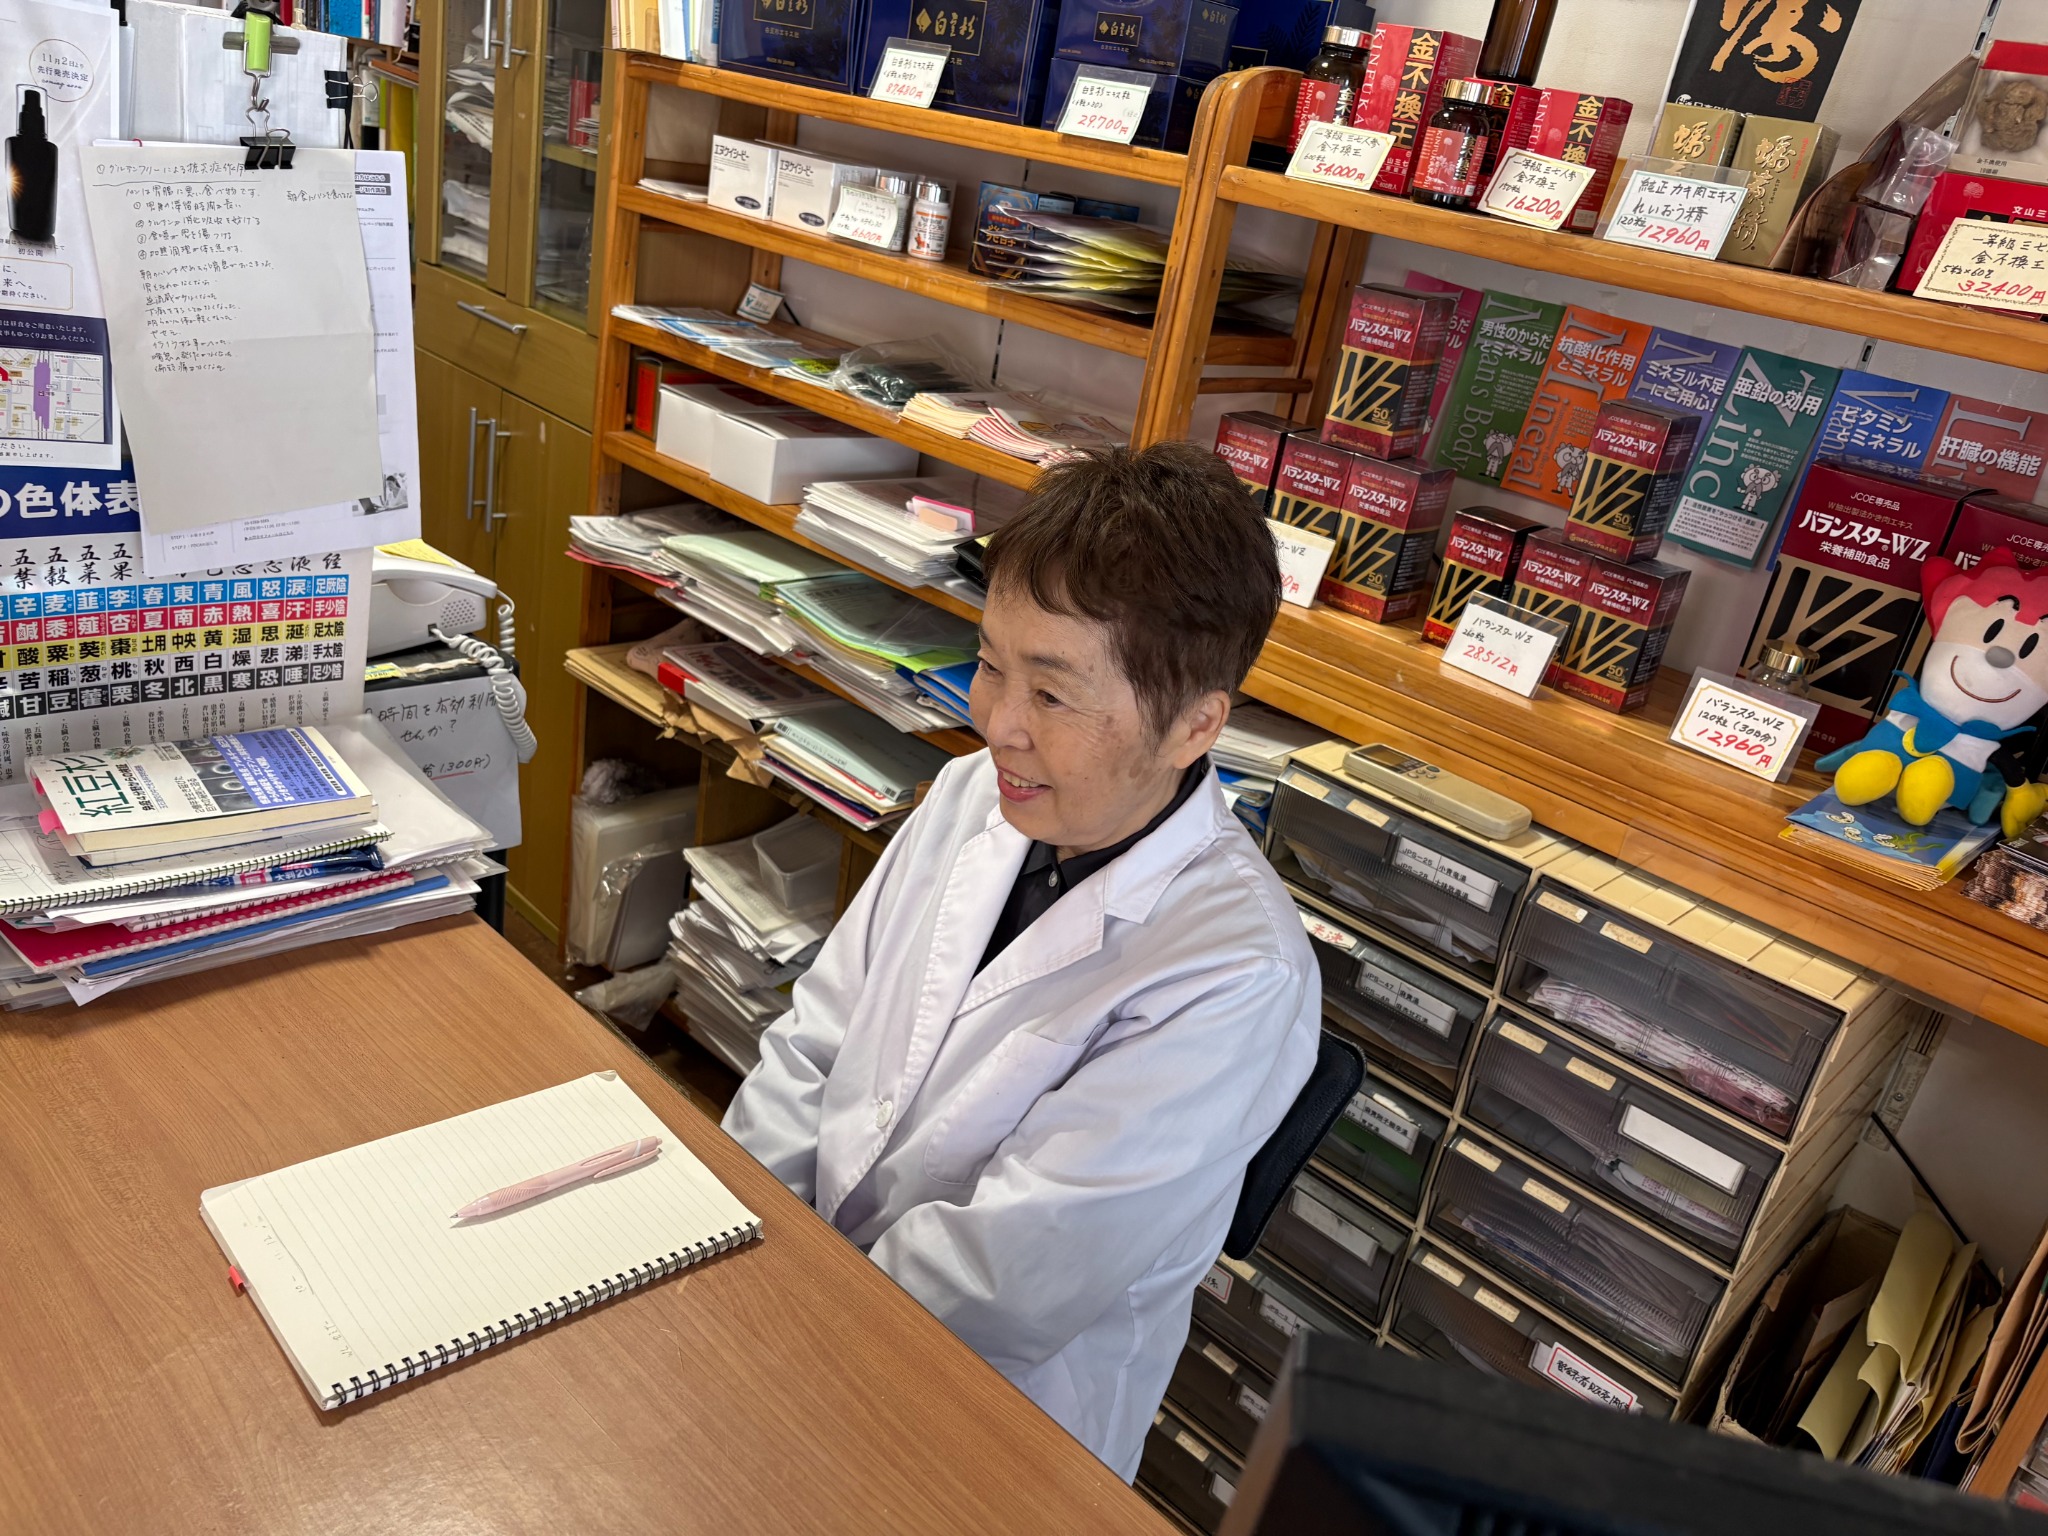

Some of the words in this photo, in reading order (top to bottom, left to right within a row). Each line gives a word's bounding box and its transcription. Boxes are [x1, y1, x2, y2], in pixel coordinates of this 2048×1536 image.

[42, 52, 85, 69] 11月2日より
[37, 65, 89, 82] 先行発売決定
[1386, 31, 1440, 149] 金不換王
[1317, 141, 1363, 158] 金不換王
[1312, 162, 1366, 182] 54,000円
[1513, 157, 1542, 175] 一等級
[1544, 165, 1578, 182] 三七人参
[1513, 170, 1558, 191] 金不換王
[1639, 177, 1668, 194] 純正
[1671, 182, 1737, 205] カキ肉エキス
[1631, 199, 1709, 224] れいおう精
[2012, 205, 2047, 219] 文山三
[1616, 215, 1647, 229] 120粒
[1638, 224, 1711, 252] 12,960円
[1972, 233, 2015, 251] 一等級
[18, 247, 44, 257] 初公開
[1971, 250, 2046, 271] 金不換王
[1957, 279, 2047, 304] 32,400円
[1349, 317, 1412, 344] バランスターWZ
[1479, 319, 1554, 350] 男性のからだ
[1479, 339, 1547, 367] とミネラル
[1556, 335, 1637, 372] 抗酸化作用
[1556, 357, 1630, 388] とミネラル
[1645, 360, 1727, 397] ミネラル不足
[1649, 383, 1719, 413] にご用心!
[1732, 376, 1824, 417] 亜鉛の効用
[1689, 352, 1816, 500] Zinc
[1839, 405, 1913, 436] ビタミン
[1441, 404, 1495, 471] Body
[1594, 428, 1657, 455] バランスターWZ
[1836, 427, 1923, 460] とミネラル
[1216, 442, 1270, 470] バランスターWZ
[1936, 435, 2043, 478] 肝臓の機能
[1282, 464, 1341, 492] バランスターWZ
[0, 480, 139, 518] 色体表
[1348, 484, 1408, 513] バランスターWZ
[1850, 491, 1901, 512] JCOE専売品
[1827, 500, 1913, 530] W抽出製法かき肉エキス
[1798, 509, 1931, 562] バランスターWZ
[1450, 535, 1504, 563] バランスターWZ
[1819, 540, 1891, 571] 栄養補助食品
[44, 546, 71, 587] 五穀
[76, 544, 102, 585] 五菜
[109, 542, 133, 581] 五果
[1522, 559, 1583, 589] バランスターWZ
[143, 587, 164, 605] 春
[174, 585, 194, 603] 東
[203, 583, 224, 601] 青
[233, 582, 253, 599] 風
[262, 581, 281, 598] 怒
[287, 579, 307, 596] 涙
[1588, 582, 1651, 612] バランスターWZ
[15, 597, 37, 616] 辛
[44, 594, 67, 614] 麦
[109, 589, 130, 608] 李
[314, 599, 346, 617] 手少陰
[174, 608, 194, 627] 南
[203, 606, 224, 625] 赤
[233, 605, 252, 622] 熱
[261, 603, 281, 620] 喜
[286, 601, 306, 618] 汗
[109, 613, 131, 633] 杏
[143, 611, 164, 629] 夏
[314, 621, 345, 638] 足太陰
[203, 629, 223, 648] 黄
[233, 627, 252, 645] 湿
[261, 625, 280, 642] 思
[1472, 617, 1513, 635] バランスター
[1515, 630, 1534, 645] WZ
[79, 641, 101, 660] 葵
[142, 634, 167, 653] 土用
[172, 632, 197, 651] 中央
[313, 642, 343, 660] 手太陰
[17, 648, 39, 666] 酸
[204, 652, 222, 670] 白
[232, 650, 252, 667] 燥
[260, 647, 279, 664] 悲
[285, 645, 303, 661] 涕
[111, 661, 132, 680] 桃
[144, 658, 165, 676] 秋
[174, 655, 194, 673] 西
[312, 663, 342, 681] 足少陰
[18, 671, 41, 691] 苦
[48, 668, 70, 687] 稲
[80, 665, 102, 684] 葱
[203, 675, 224, 693] 黒
[232, 672, 252, 689] 寒
[260, 669, 279, 687] 恐
[285, 667, 303, 684] 唾
[111, 684, 133, 704] 栗
[145, 681, 166, 699] 冬
[174, 678, 195, 696] 北
[20, 695, 42, 715] 甘
[50, 692, 72, 712] 豆
[1706, 697, 1760, 722] バランスター
[1762, 716, 1785, 731] WZ
[1697, 710, 1728, 728] 120粒
[1733, 721, 1777, 748] (30日分)
[1696, 727, 1773, 769] 12,960円
[50, 754, 135, 818] 紅豆杉
[1312, 922, 1345, 944] 未決
